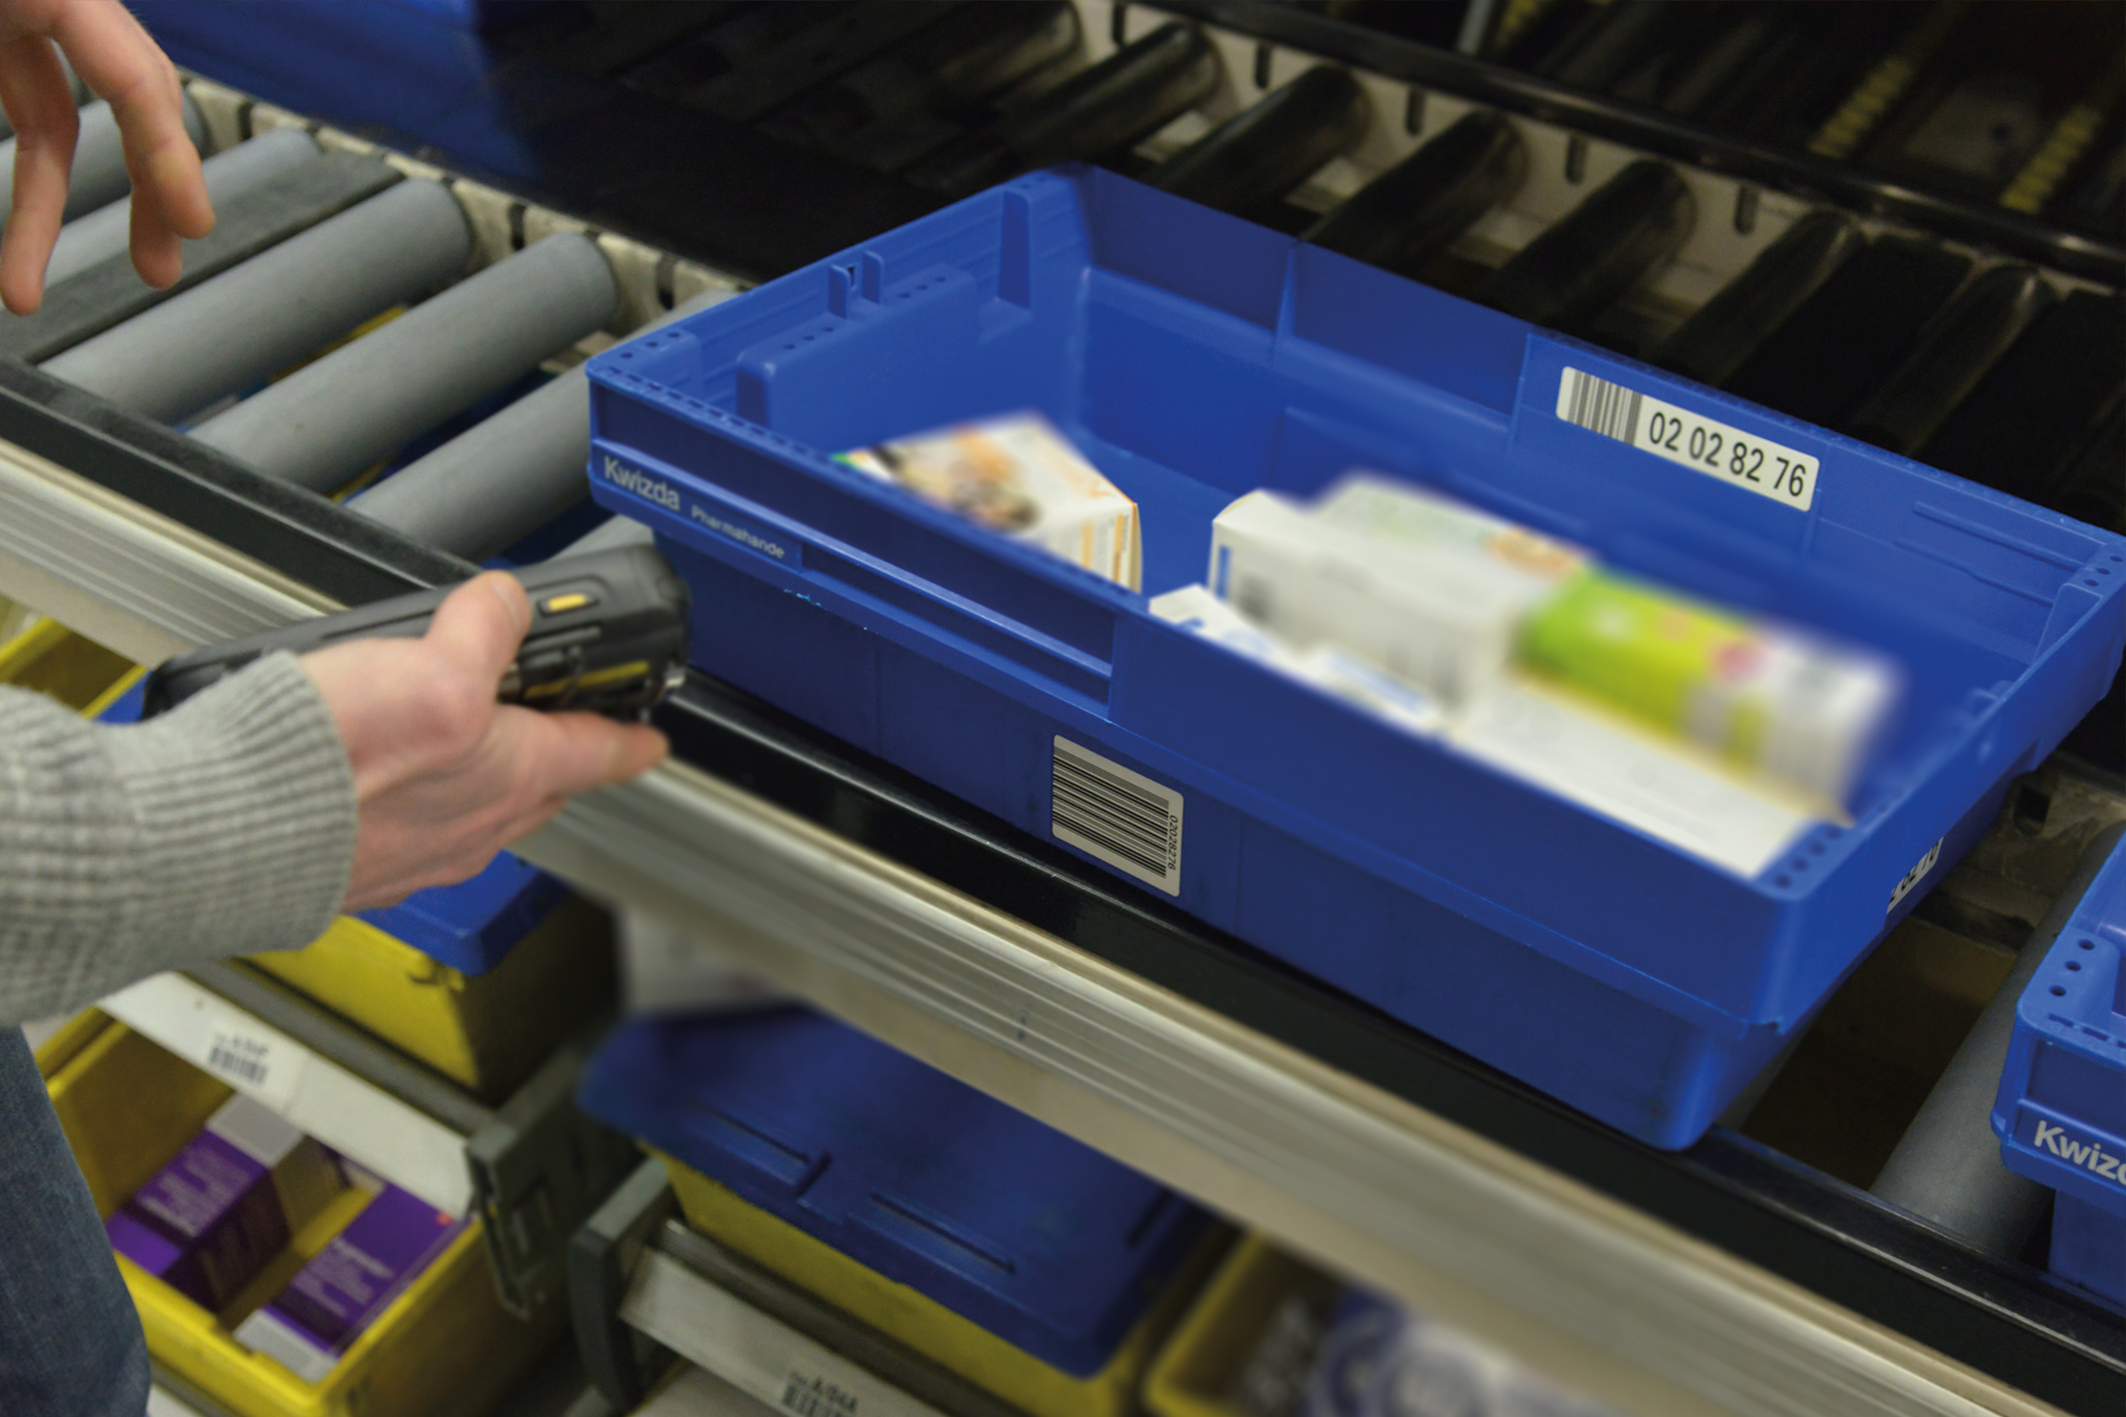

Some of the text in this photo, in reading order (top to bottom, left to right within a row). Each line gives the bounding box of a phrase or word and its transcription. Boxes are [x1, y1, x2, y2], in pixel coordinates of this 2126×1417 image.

[1649, 412, 1807, 497] 02 02 82 76
[604, 456, 680, 512] Kwizda
[1167, 814, 1179, 871] 02028276
